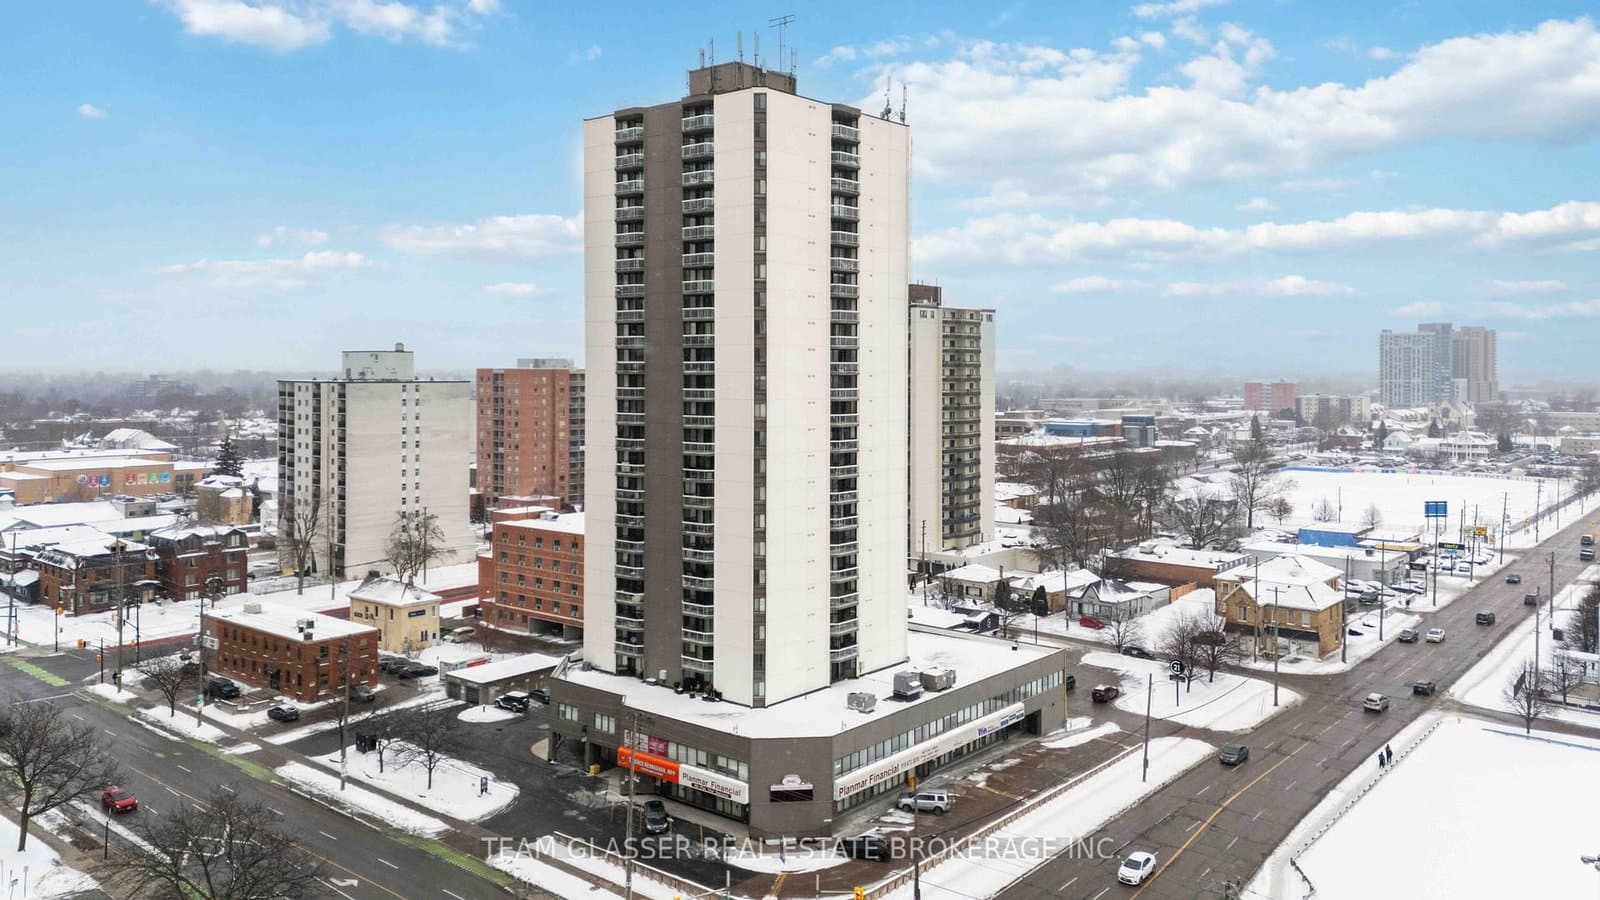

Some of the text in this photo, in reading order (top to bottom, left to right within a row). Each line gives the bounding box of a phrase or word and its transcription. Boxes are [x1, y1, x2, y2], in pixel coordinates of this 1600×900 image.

[682, 772, 708, 785] Planmar
[711, 781, 741, 797] Financial
[839, 763, 899, 797] Planmar Financial
